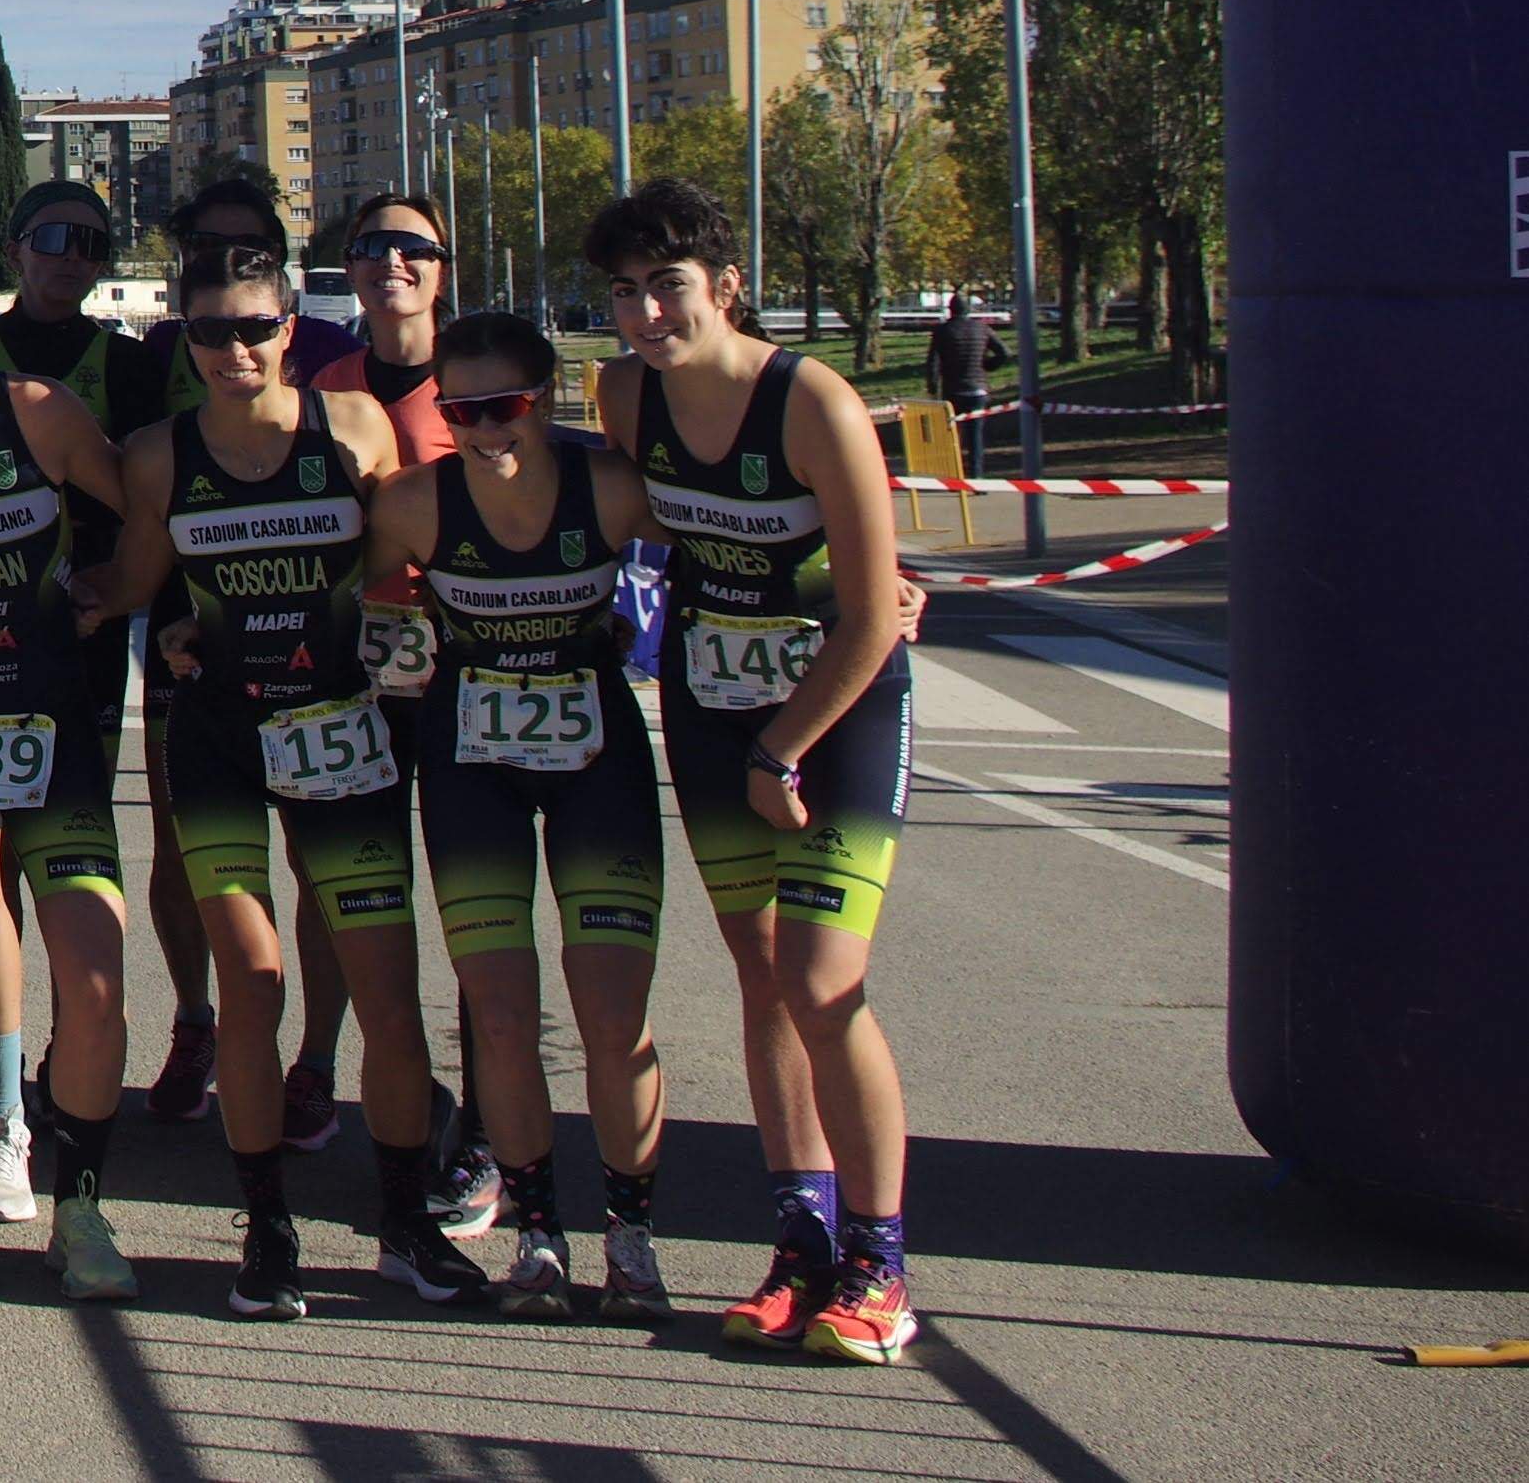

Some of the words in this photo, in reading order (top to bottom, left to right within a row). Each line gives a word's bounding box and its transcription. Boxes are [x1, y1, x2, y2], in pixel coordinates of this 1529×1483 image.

[190, 522, 248, 546] STADIUM
[251, 514, 340, 539] CASABLANCA
[697, 507, 790, 535] CASABLANCA
[215, 555, 328, 597] COSCOLLA
[451, 588, 507, 608] STADIUM
[511, 583, 597, 608] CASABLANCA
[702, 580, 760, 605] MAPEI
[245, 612, 305, 632] MAPEI
[474, 615, 580, 643] OYARBIDE
[497, 651, 556, 668] MAPEI
[264, 683, 312, 695] Zaragoza
[480, 691, 592, 742] 125
[284, 711, 384, 780] 151
[891, 770, 909, 817] STADIUM
